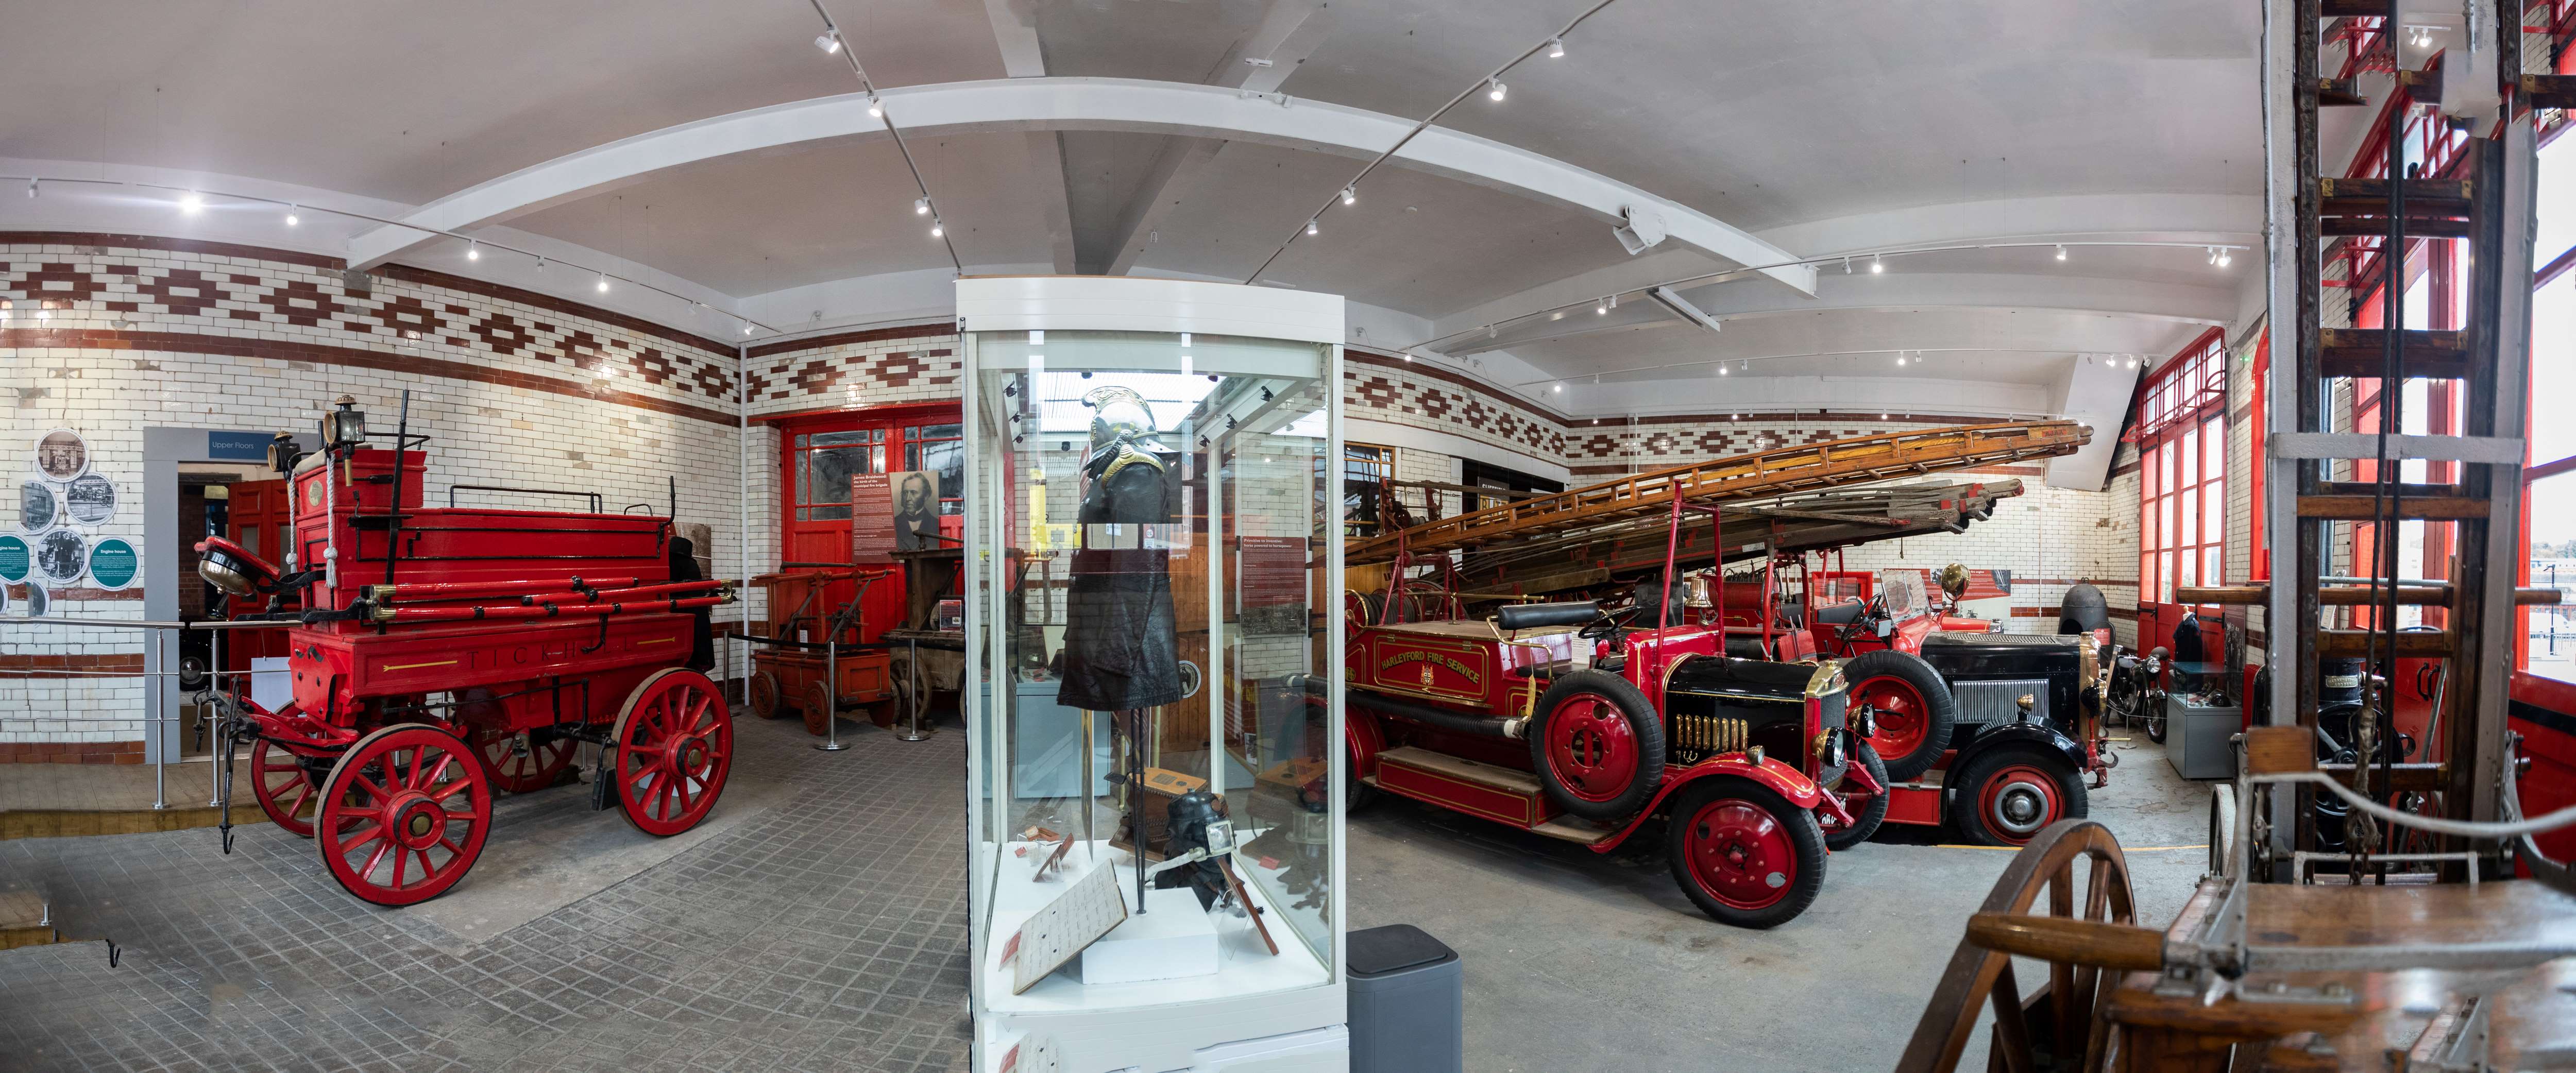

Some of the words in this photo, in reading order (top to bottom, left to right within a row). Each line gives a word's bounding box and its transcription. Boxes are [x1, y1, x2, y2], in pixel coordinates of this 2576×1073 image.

[1381, 651, 1425, 671] HARLEYFORD
[1427, 651, 1444, 666] FIRE
[1446, 657, 1480, 685] SERVICE
